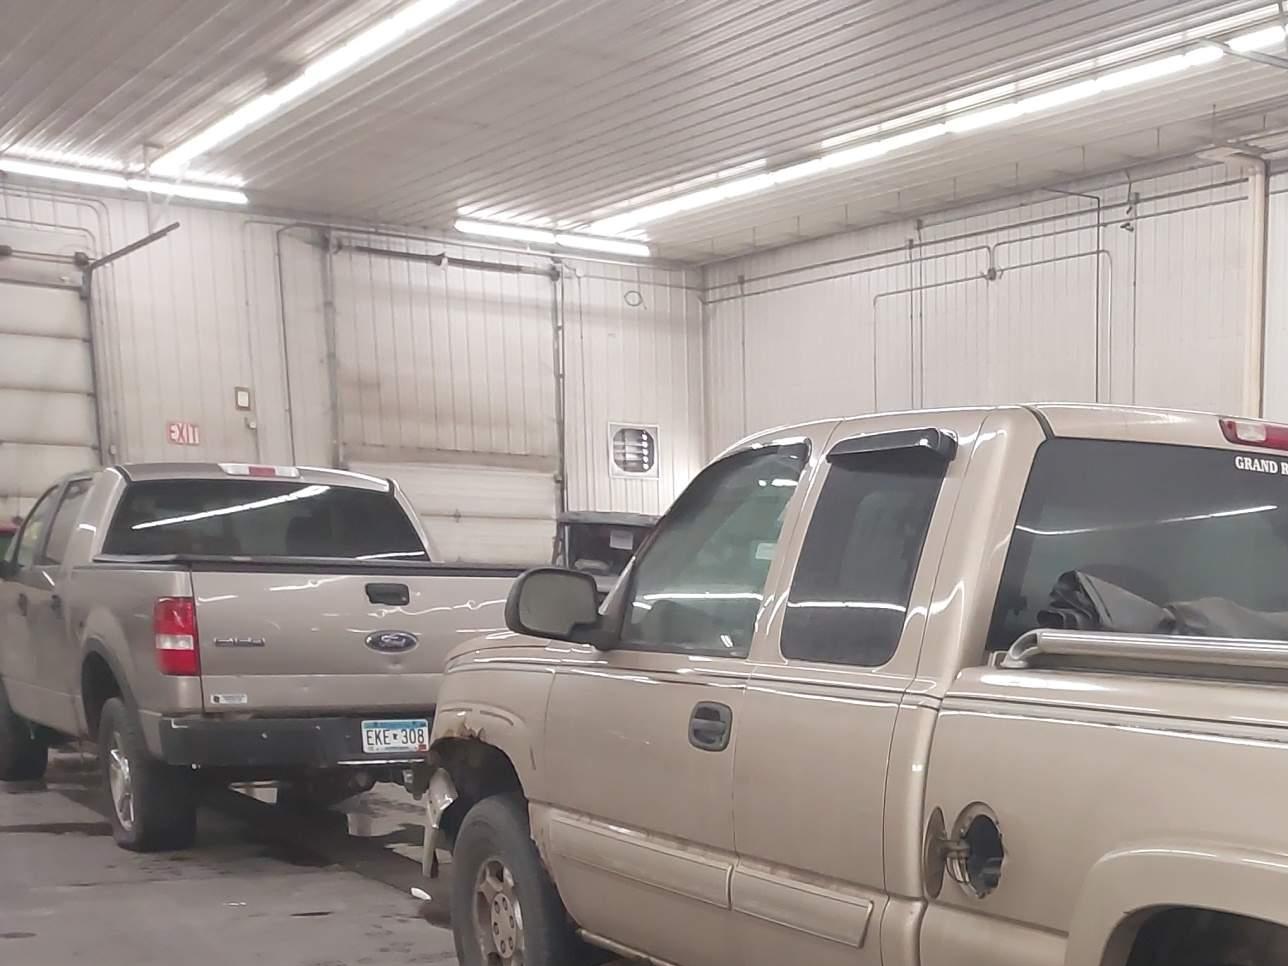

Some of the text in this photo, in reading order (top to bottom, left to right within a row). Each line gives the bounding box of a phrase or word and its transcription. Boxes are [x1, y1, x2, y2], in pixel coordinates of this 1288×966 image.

[169, 422, 200, 444] EXIT
[1234, 456, 1278, 474] GRAND
[366, 729, 425, 746] EKE 308
